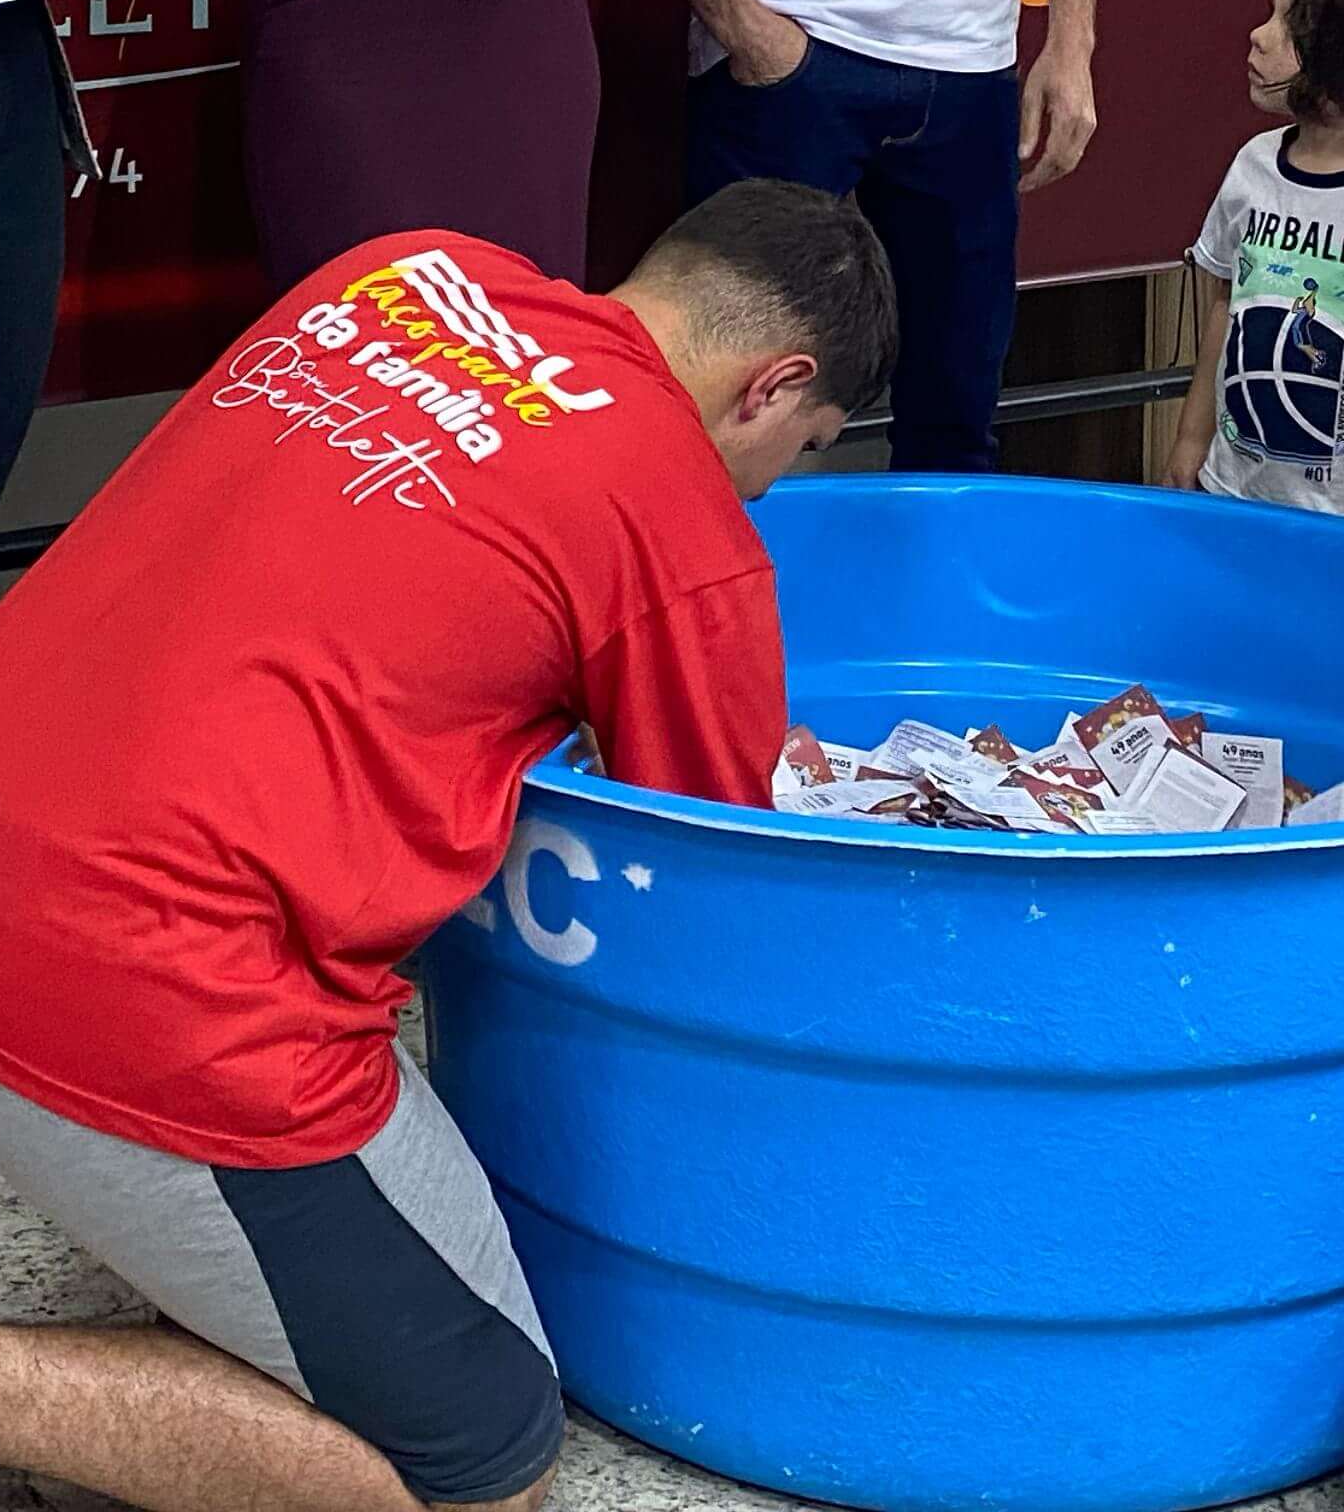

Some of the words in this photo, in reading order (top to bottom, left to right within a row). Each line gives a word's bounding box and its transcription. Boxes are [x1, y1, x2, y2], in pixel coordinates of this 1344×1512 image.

[296, 302, 360, 351] da
[212, 333, 457, 510] Bertoletti
[1304, 466, 1333, 483] #01
[1222, 743, 1239, 757] 49
[1238, 747, 1265, 761] anos
